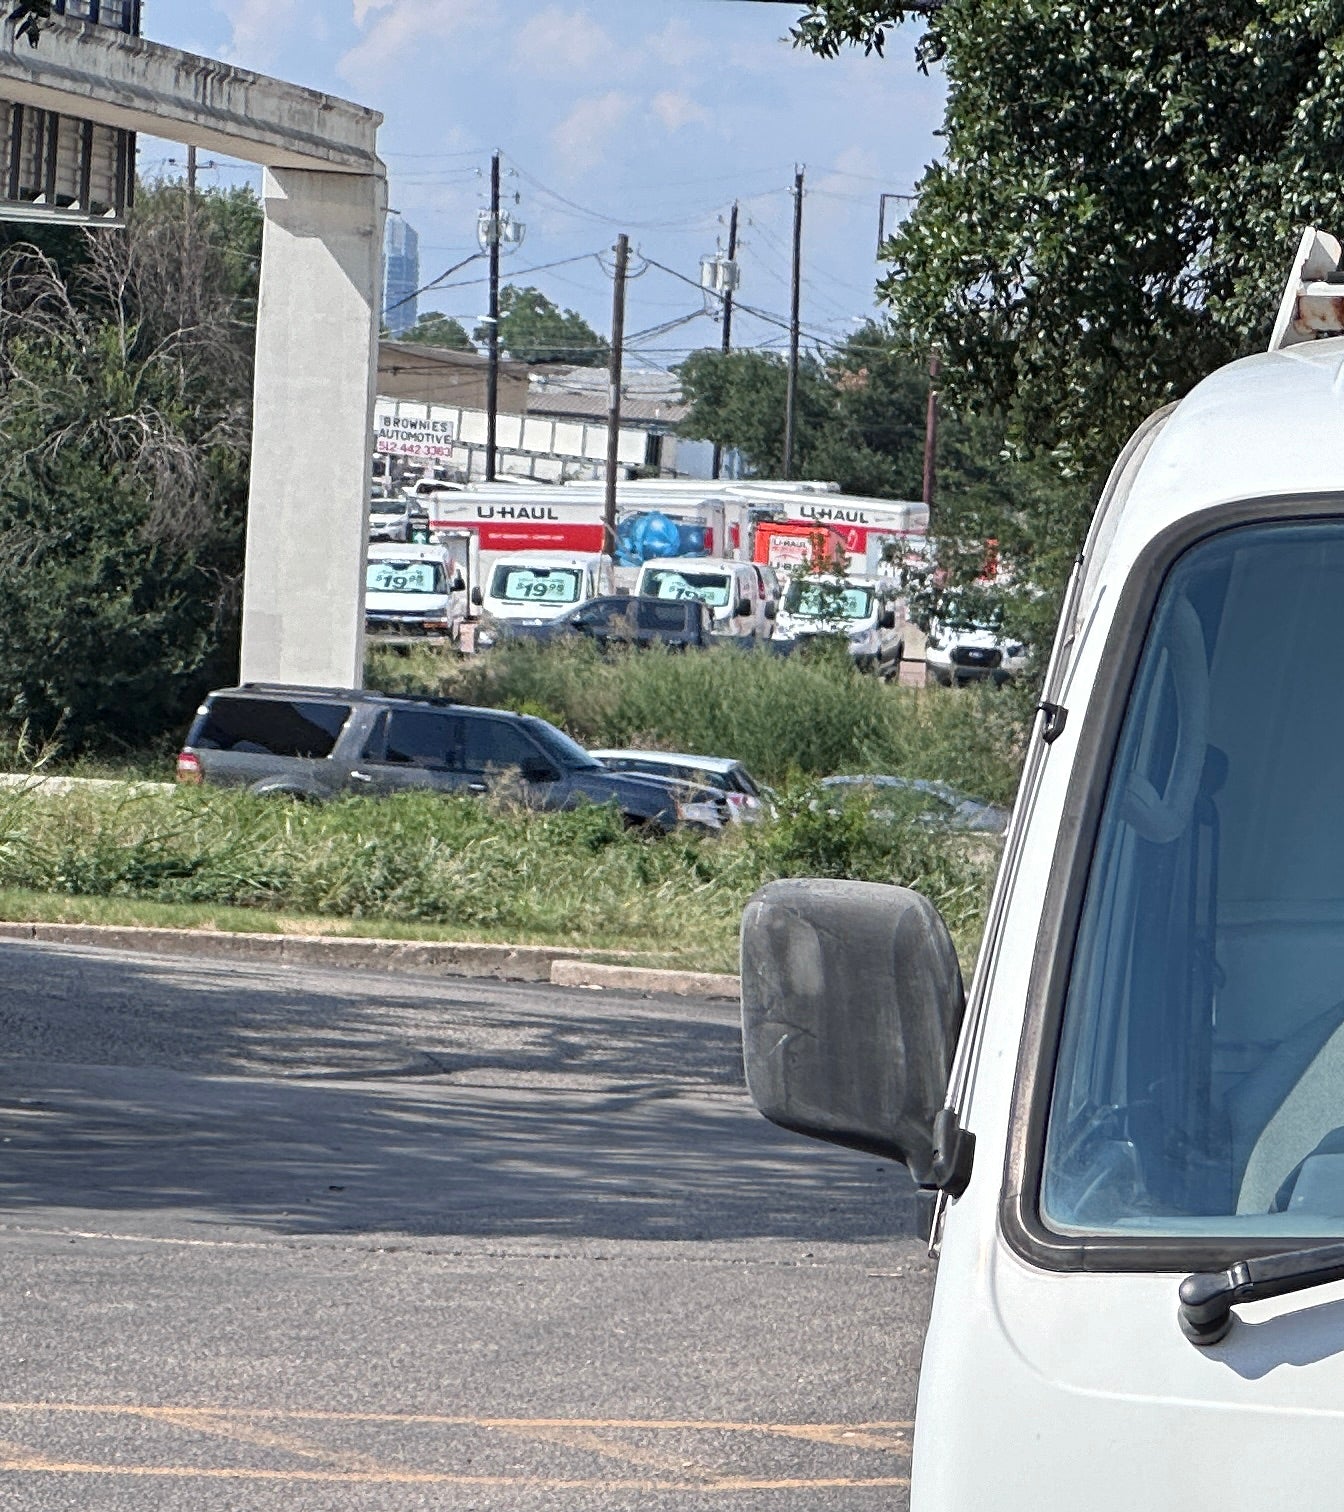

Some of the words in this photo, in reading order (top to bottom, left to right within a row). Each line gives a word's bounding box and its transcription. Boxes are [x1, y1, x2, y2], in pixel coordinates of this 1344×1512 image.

[383, 416, 448, 432] BROWNIES
[379, 427, 452, 445] AUTOMOTIVE
[477, 506, 559, 520] U-HAUL
[800, 506, 869, 524] U-HAUL
